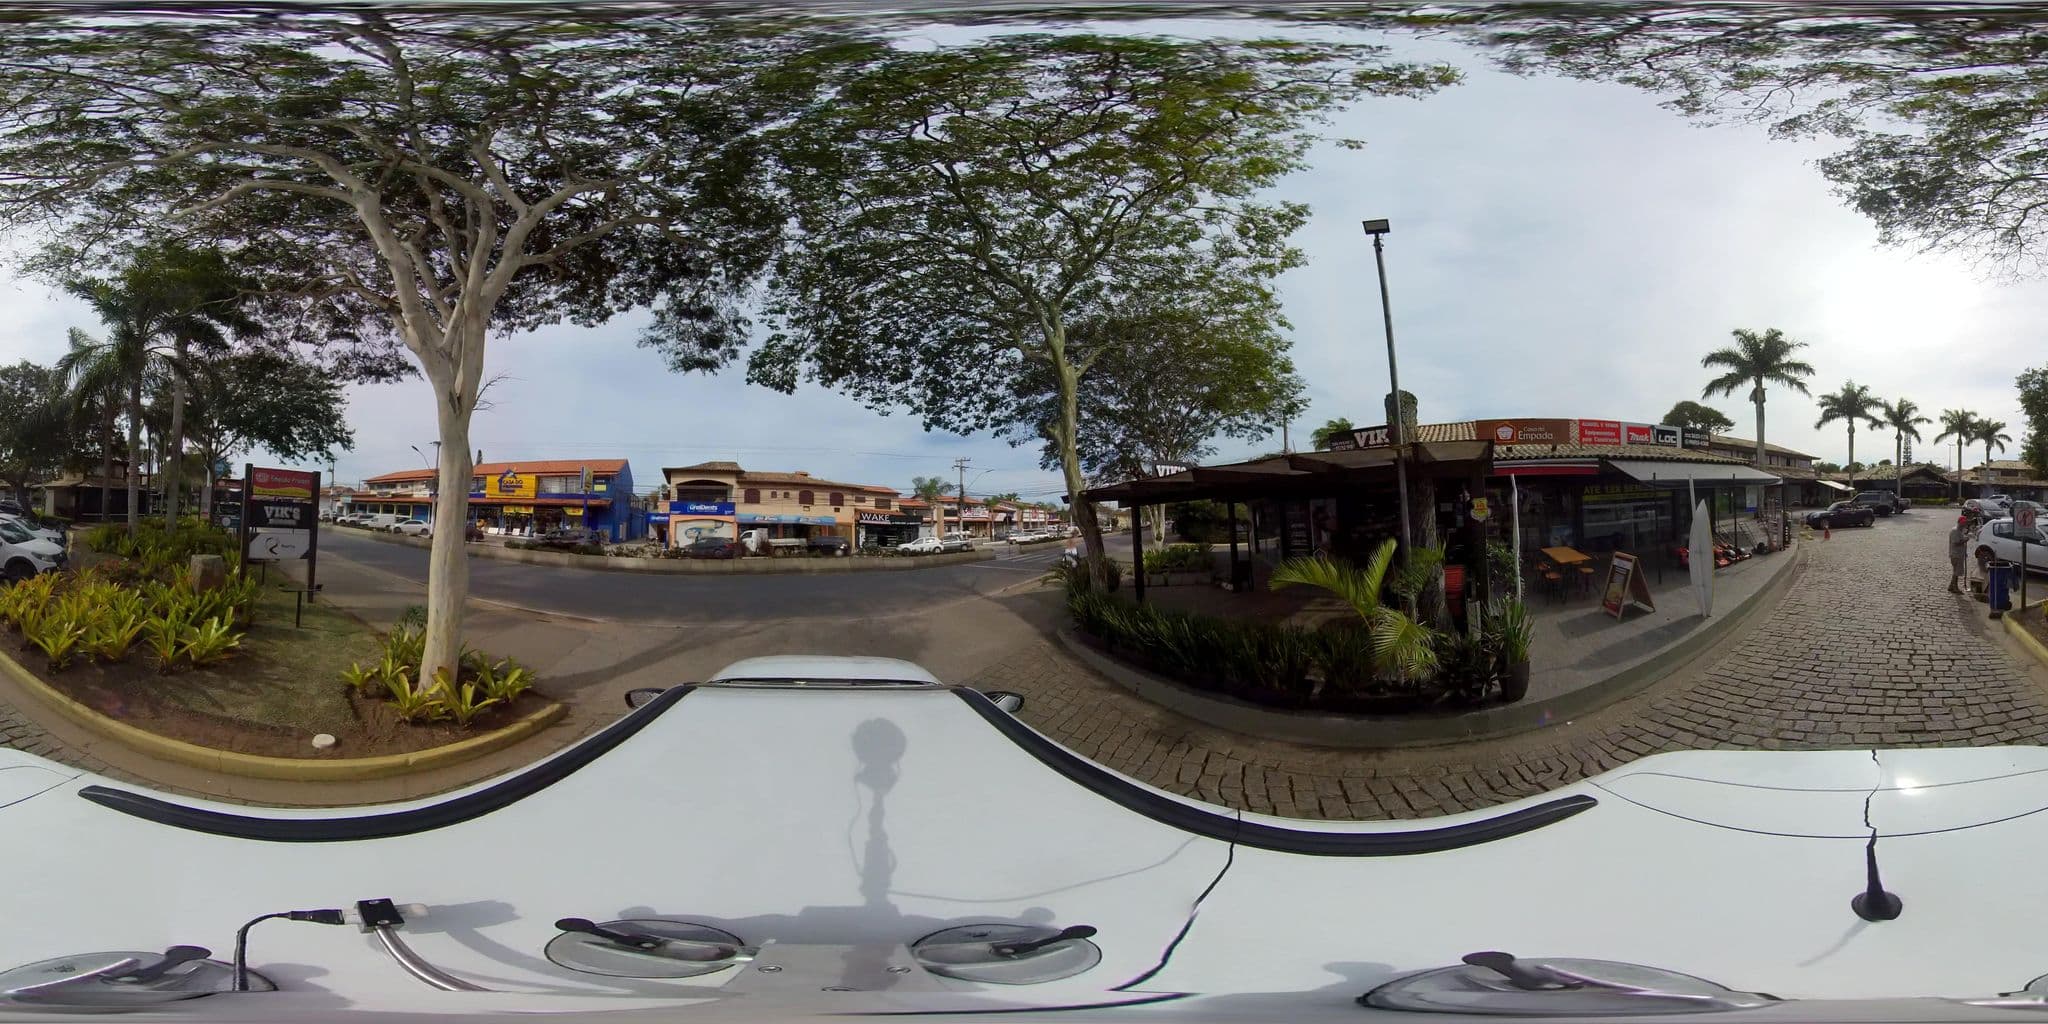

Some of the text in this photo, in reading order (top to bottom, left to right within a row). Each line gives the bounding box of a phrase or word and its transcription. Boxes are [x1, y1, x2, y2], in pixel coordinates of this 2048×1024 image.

[1518, 430, 1553, 441] Empada
[1658, 434, 1677, 443] LOC
[264, 506, 301, 520] VIK'S
[861, 513, 890, 521] WAKE
